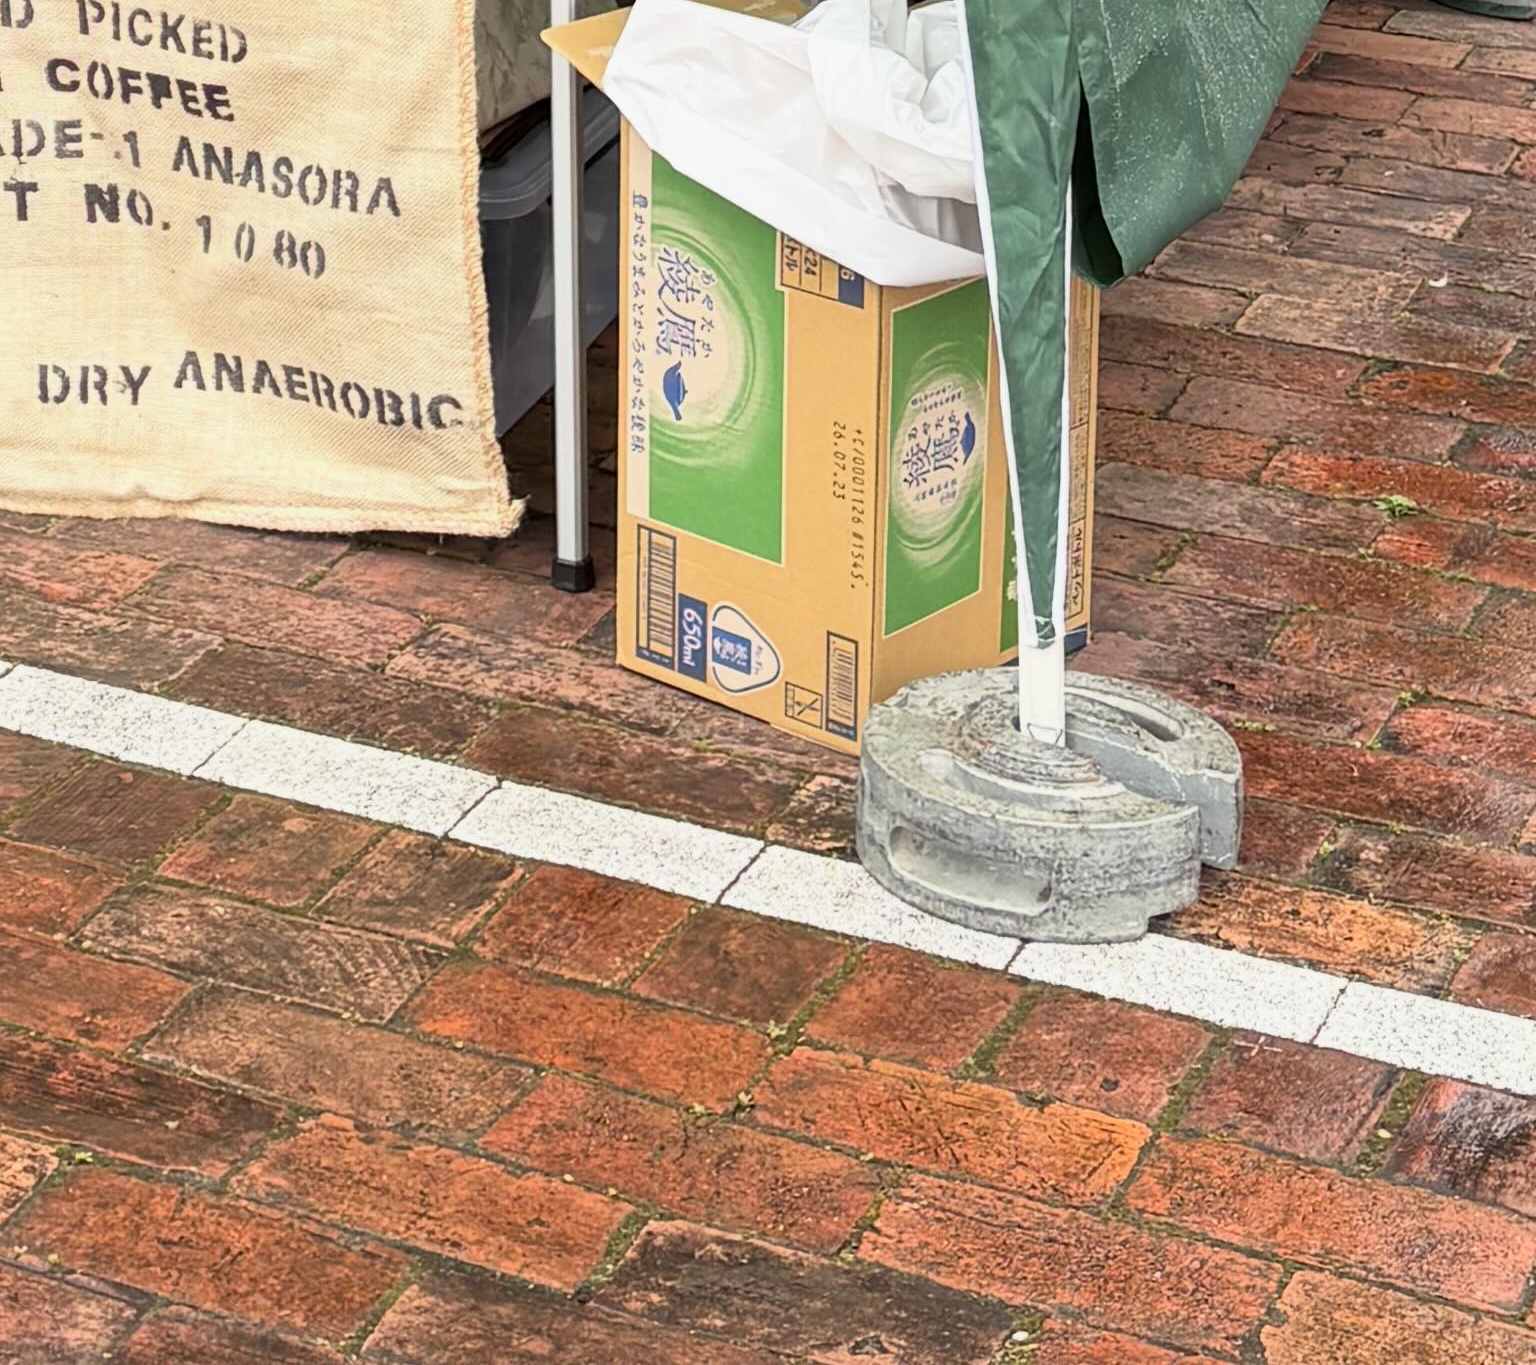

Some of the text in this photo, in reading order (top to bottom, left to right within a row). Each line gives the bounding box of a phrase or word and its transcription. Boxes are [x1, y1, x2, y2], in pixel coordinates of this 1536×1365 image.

[45, 57, 235, 122] COFFEE
[85, 182, 171, 231] NO.
[172, 135, 401, 218] ANASORA
[656, 247, 701, 359] 綾鷹
[700, 269, 716, 358] あやたか
[37, 364, 151, 406] DRY
[172, 350, 464, 432] ANAEROBIC
[833, 421, 846, 501] 26.07.23
[902, 427, 960, 489] 綾鷹
[682, 607, 703, 666] 650ml
